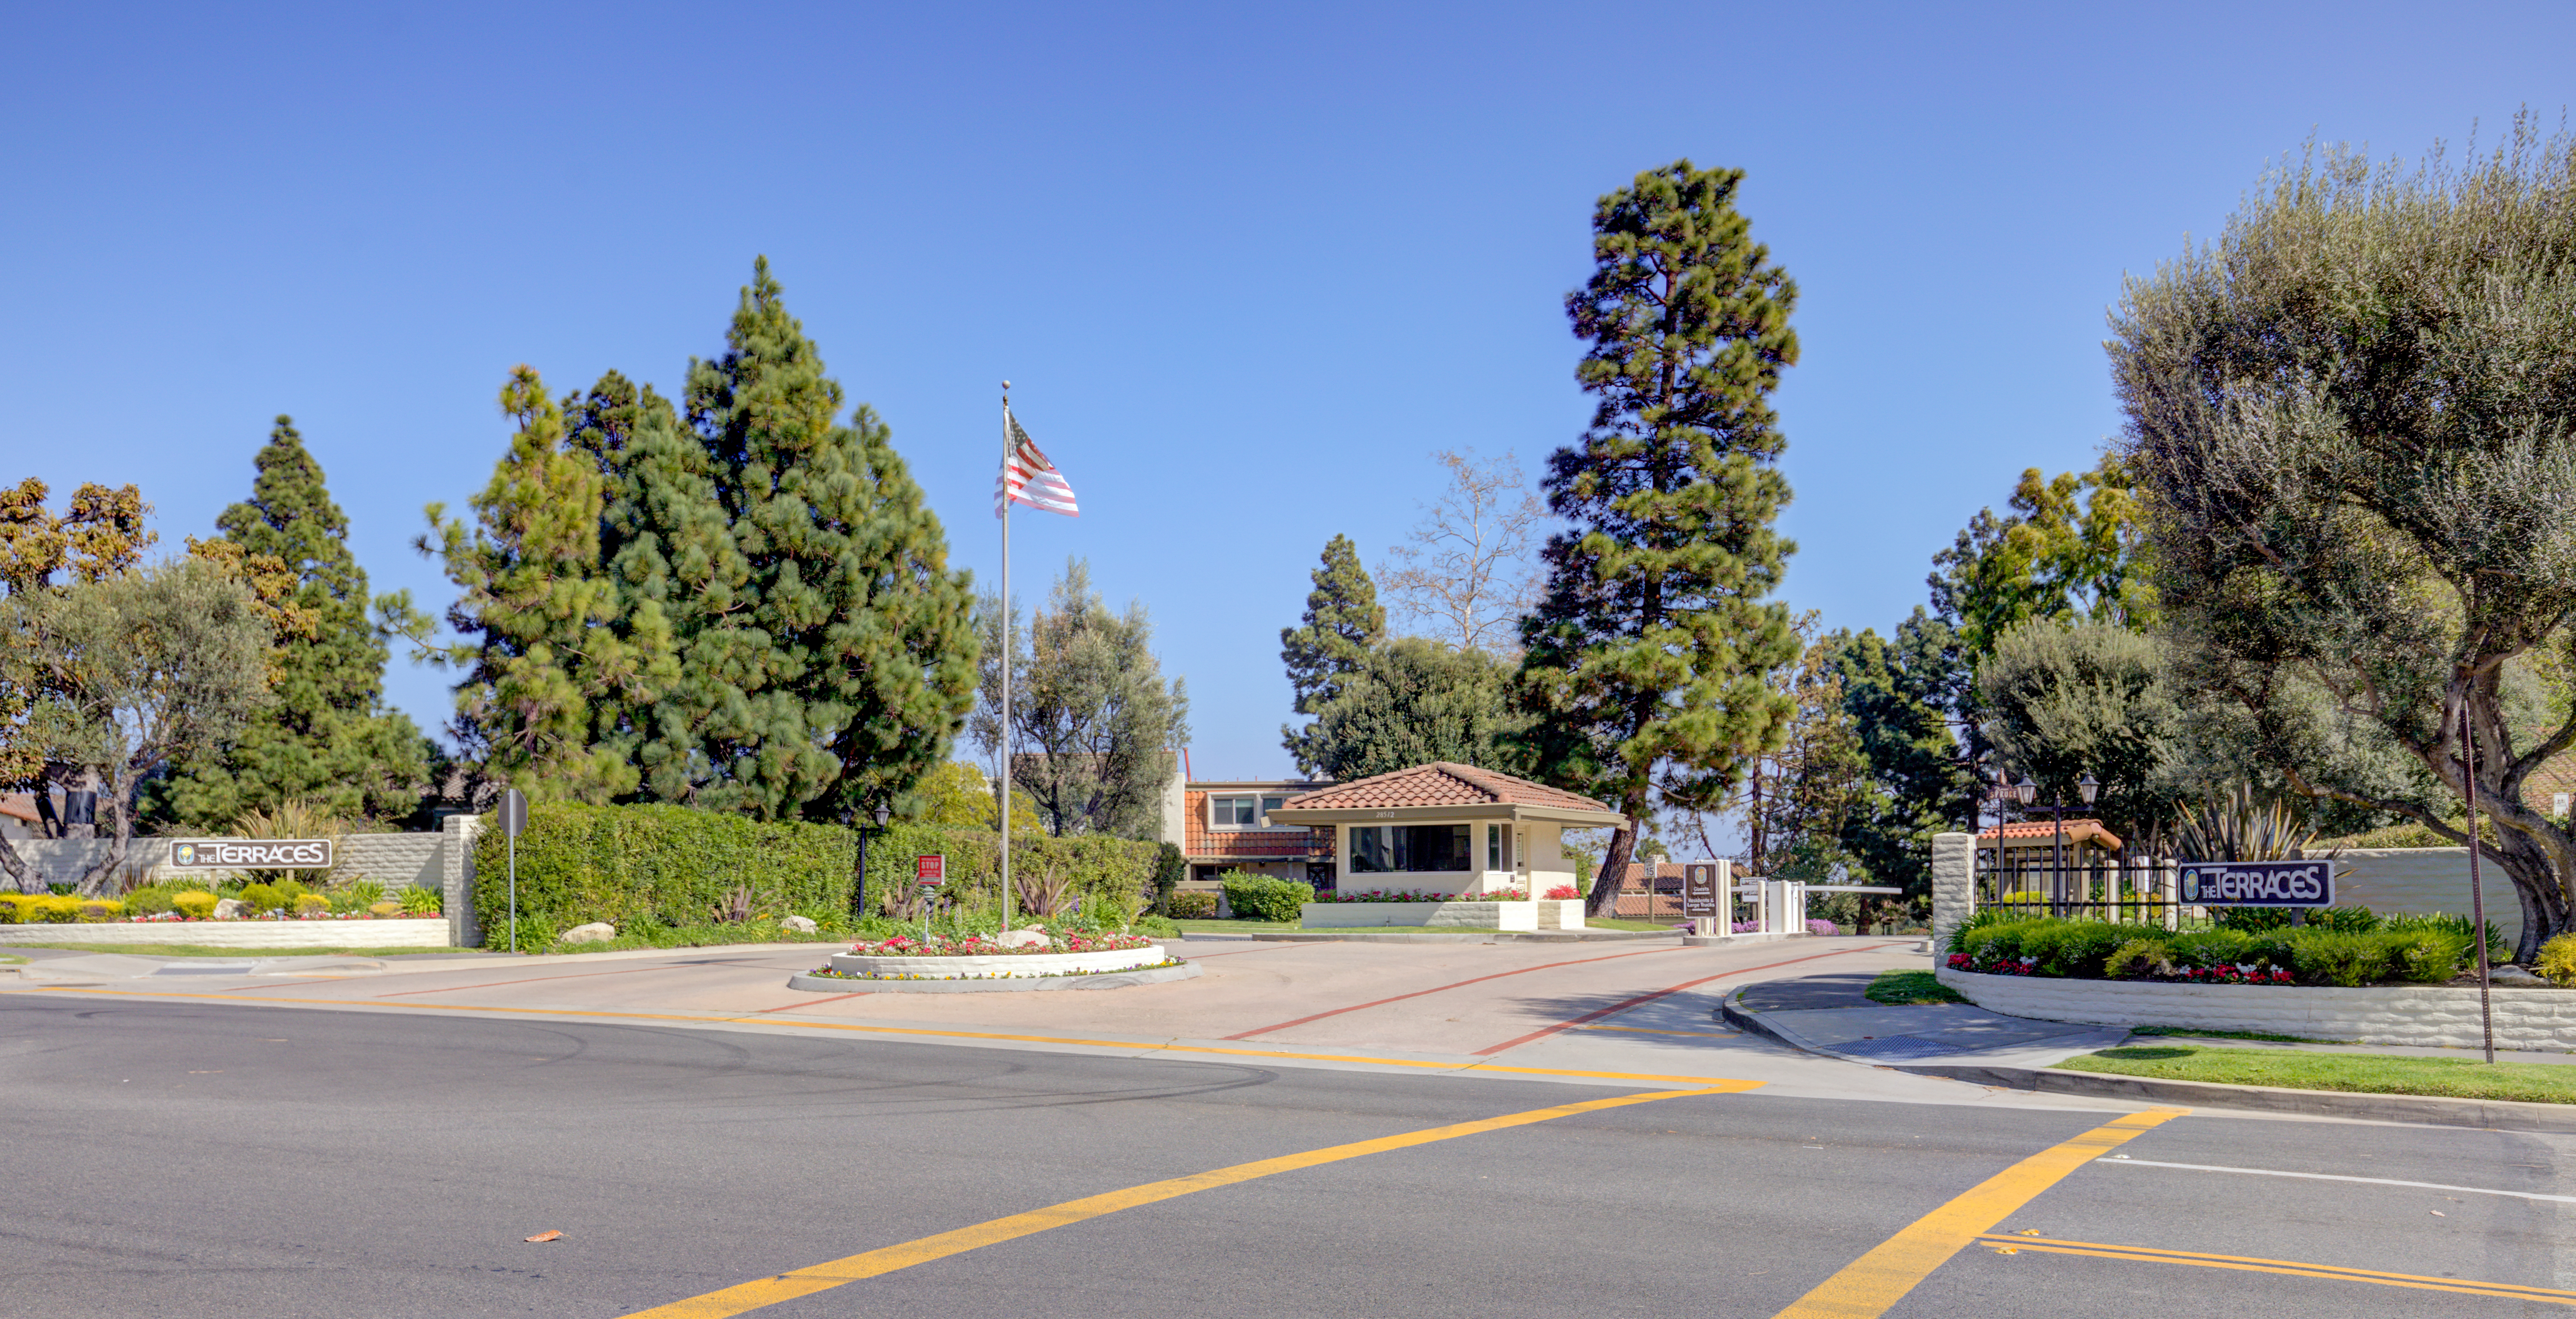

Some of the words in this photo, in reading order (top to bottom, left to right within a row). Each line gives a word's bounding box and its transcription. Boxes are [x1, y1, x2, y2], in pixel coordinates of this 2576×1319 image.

[1989, 790, 2017, 798] SPRUCE
[198, 843, 323, 863] TERRACES
[199, 854, 215, 864] THE
[1646, 867, 1654, 876] 15
[2200, 867, 2322, 899] TERRACES
[2200, 885, 2217, 899] THE
